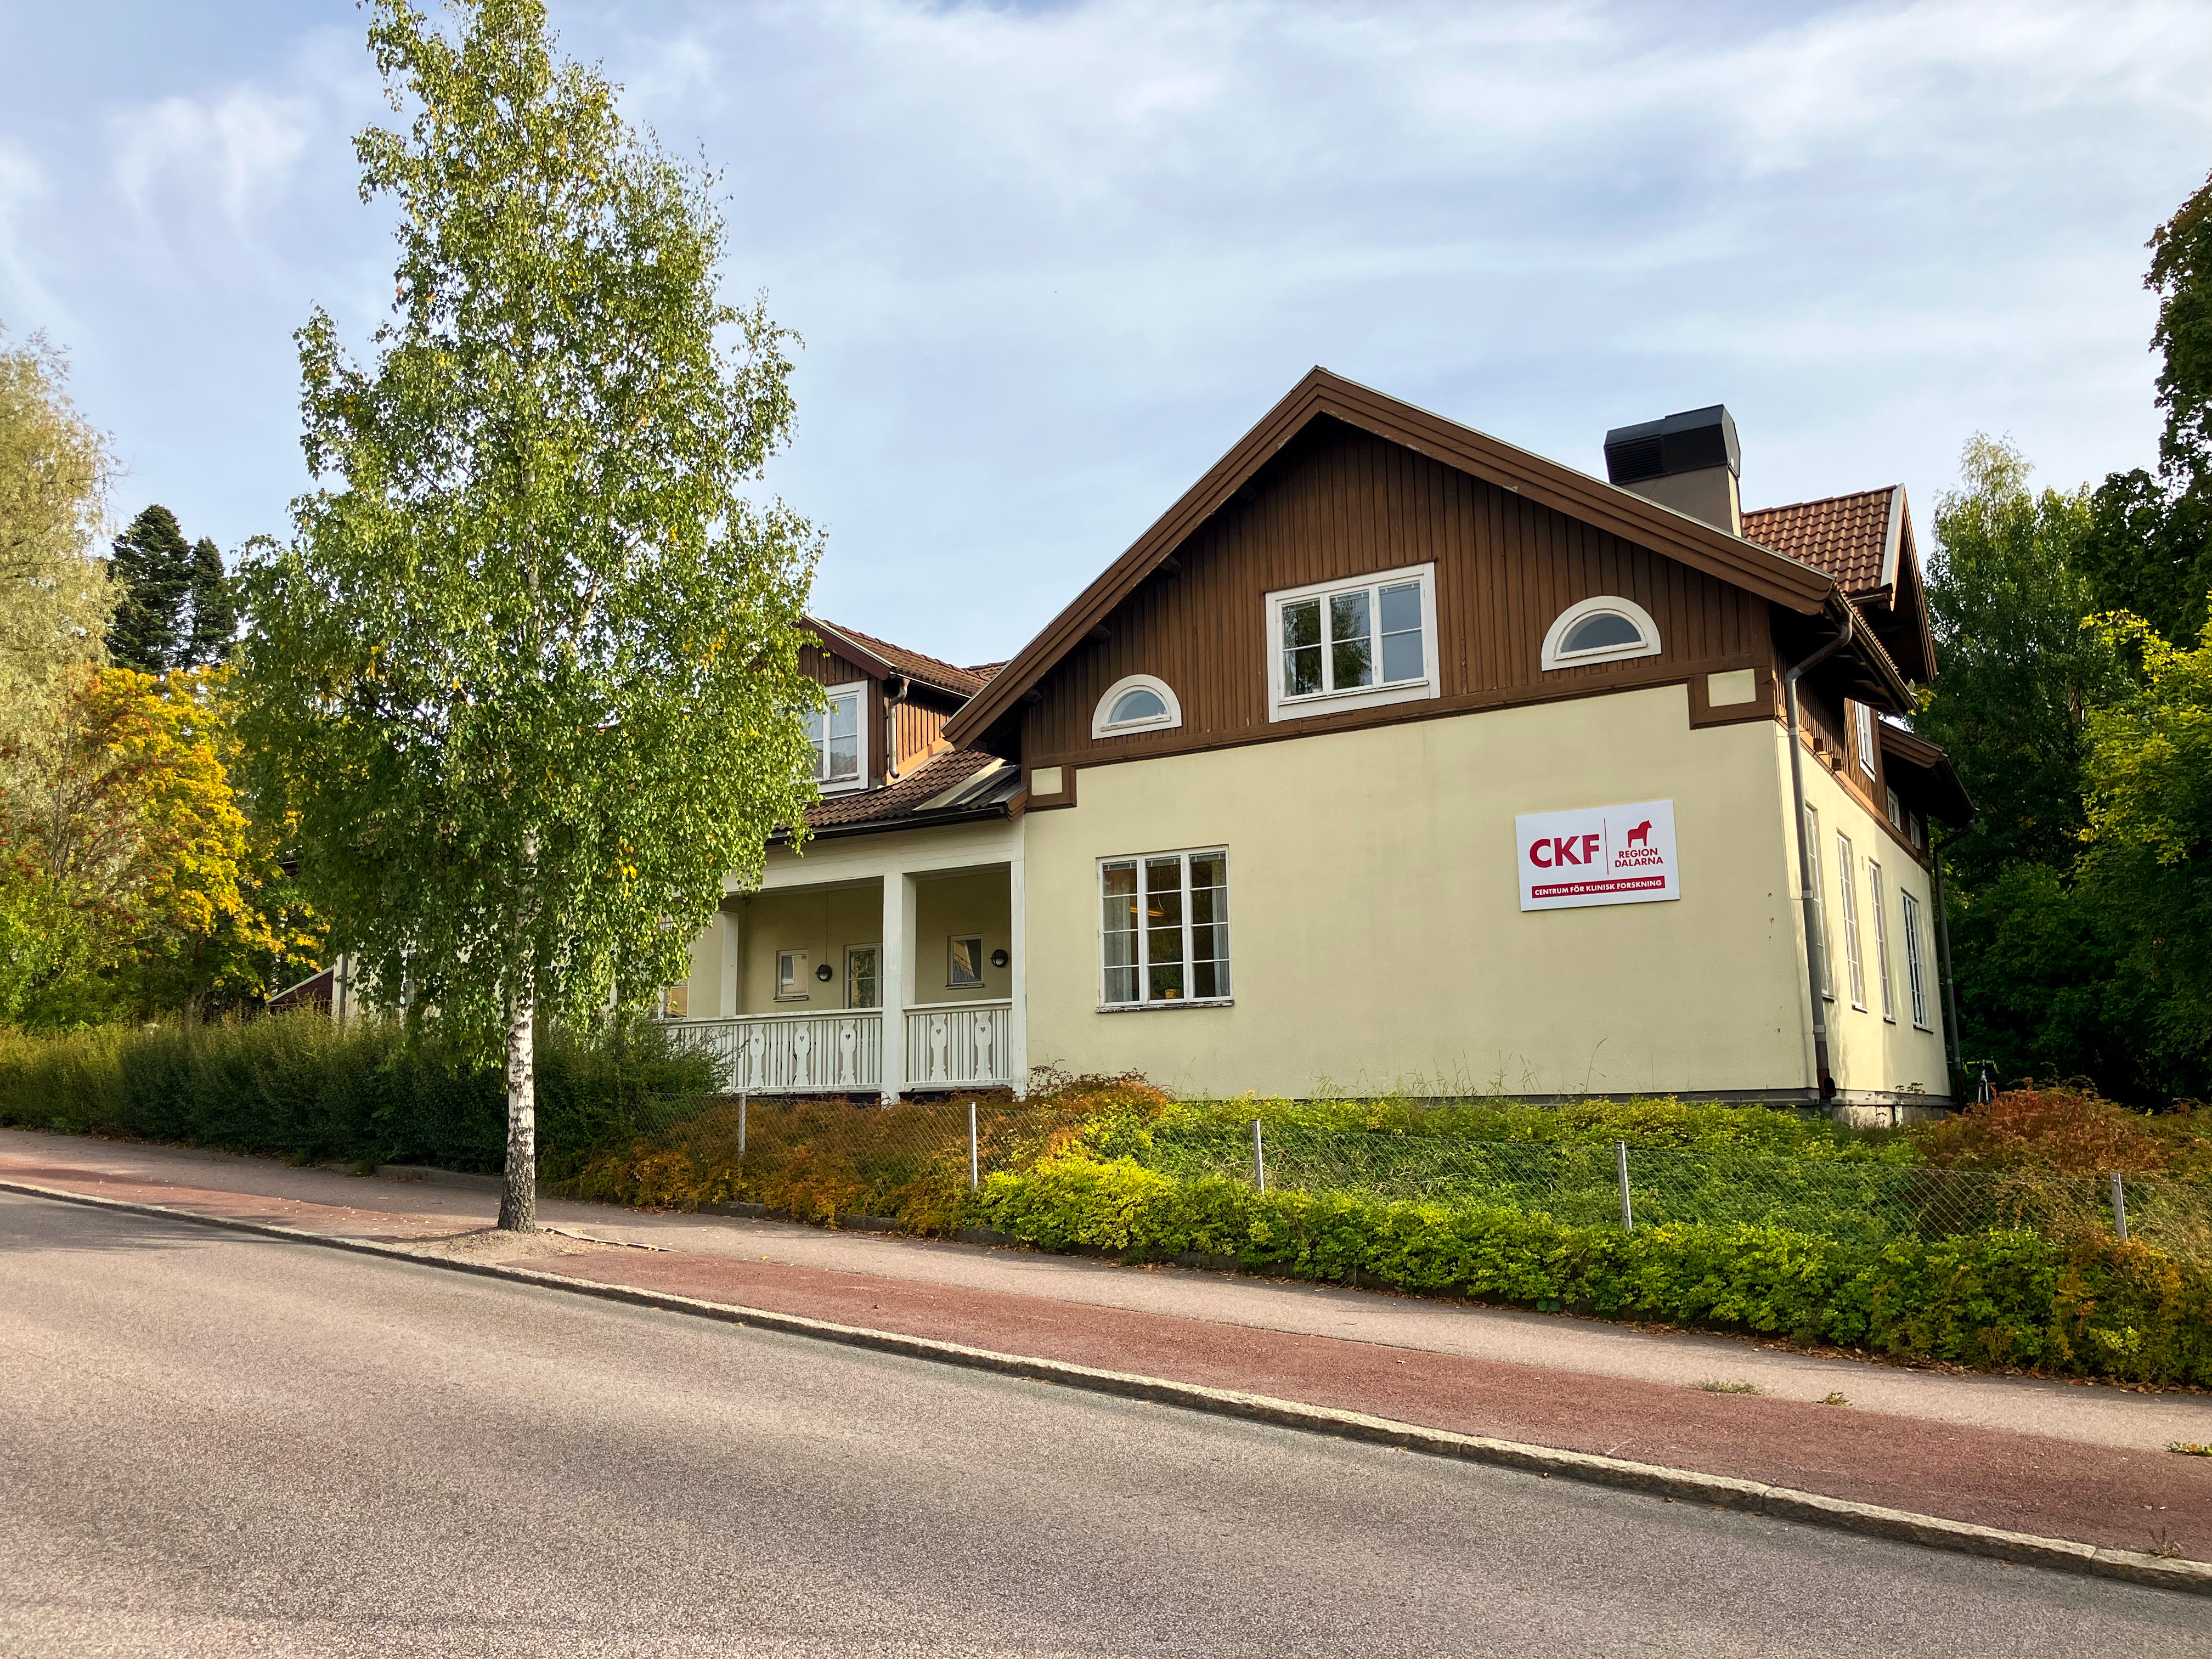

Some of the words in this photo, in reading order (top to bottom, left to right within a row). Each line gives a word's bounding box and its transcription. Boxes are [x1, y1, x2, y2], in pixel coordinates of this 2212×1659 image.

[1530, 834, 1599, 868] CKF
[1618, 848, 1658, 859] REGION
[1615, 856, 1663, 868] DALARNA
[1534, 888, 1568, 896] CENTRUM
[1570, 885, 1584, 893] FÖR
[1586, 883, 1615, 892] KLINISK
[1617, 880, 1662, 889] FORSKNING
